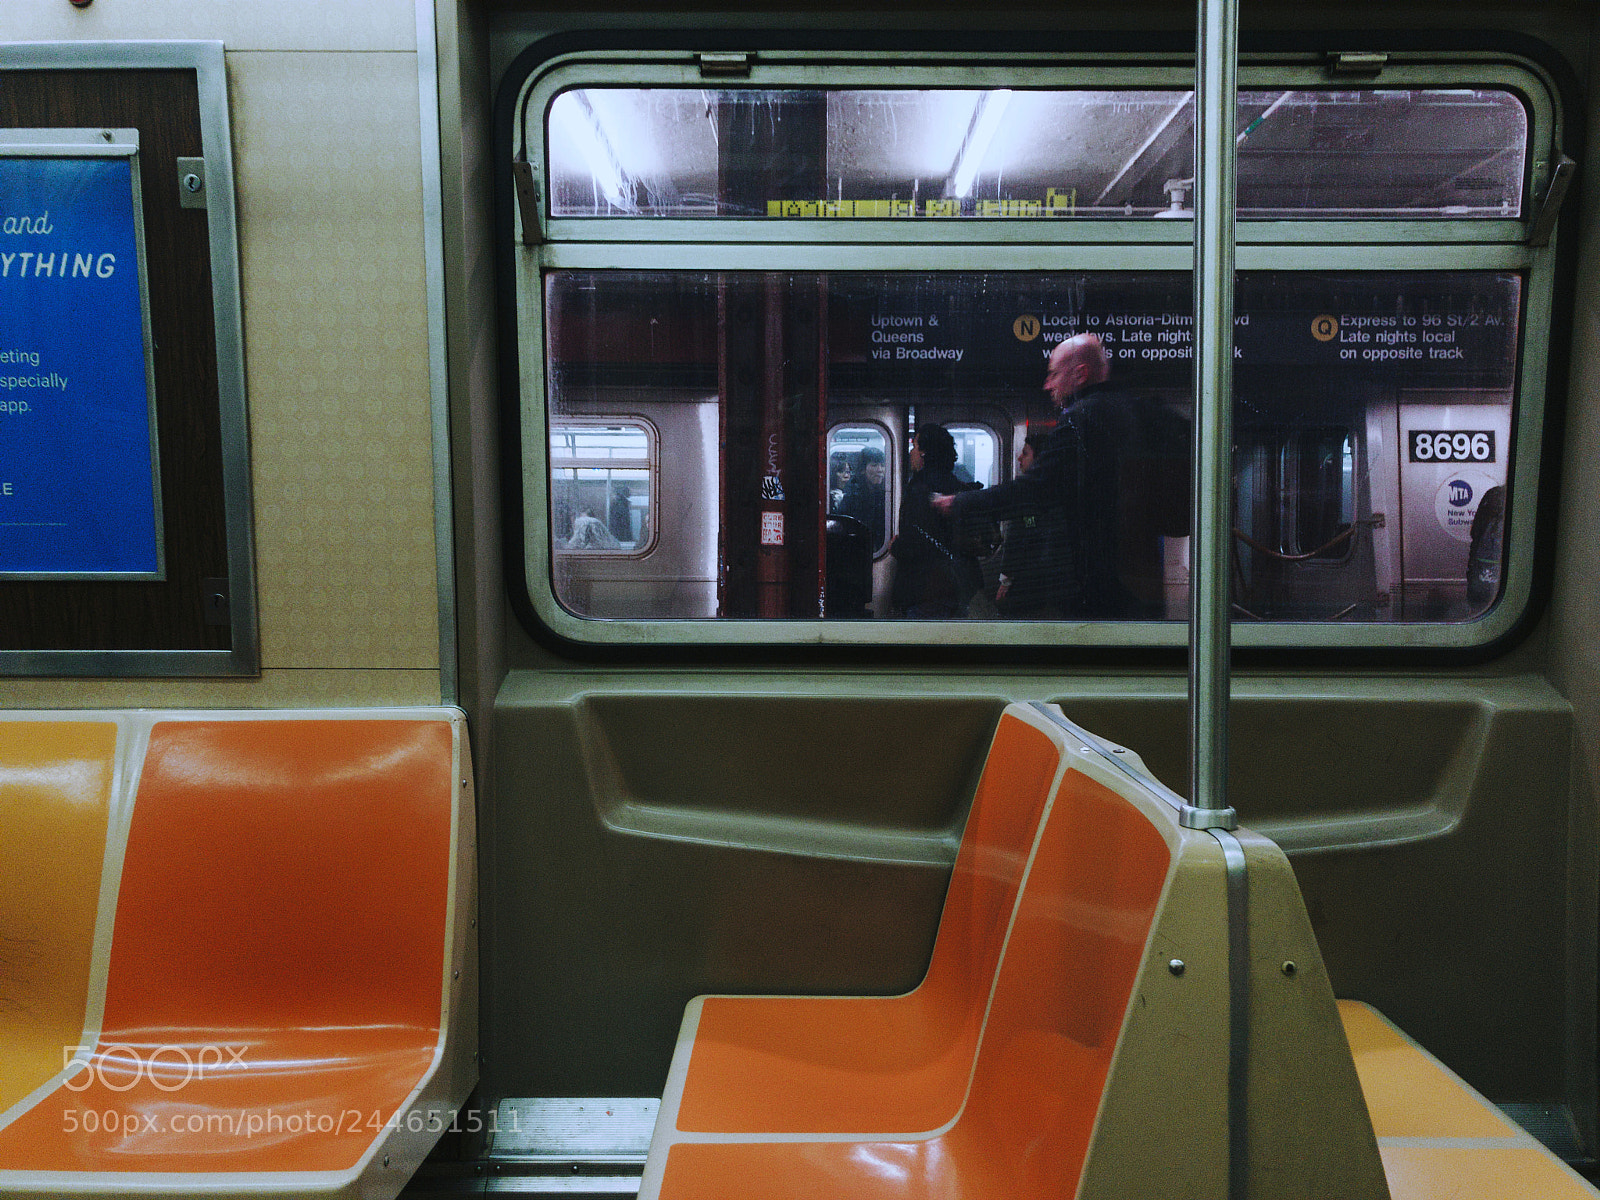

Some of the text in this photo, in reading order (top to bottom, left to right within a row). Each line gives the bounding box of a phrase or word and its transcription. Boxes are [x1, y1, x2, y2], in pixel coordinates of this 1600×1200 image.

[3, 210, 54, 235] and
[1, 252, 116, 279] YTHING
[871, 314, 939, 329] Uptown &
[1042, 312, 1250, 327] Local to Astoria-Ditm vd
[1340, 314, 1397, 329] Express
[1402, 314, 1417, 326] to
[1422, 314, 1442, 326] 96
[1447, 313, 1479, 328] St/2
[871, 330, 924, 343] Queens
[1122, 329, 1152, 343] Late
[1157, 329, 1194, 345] night
[1340, 330, 1455, 345] Late nights local
[0, 348, 40, 367] eting
[871, 346, 964, 362] via Broadway
[1119, 347, 1136, 359] on
[1141, 345, 1194, 361] opposit
[1339, 346, 1465, 362] on opposite track
[0, 400, 32, 415] app.
[1414, 432, 1490, 460] 8696
[0, 482, 14, 495] E
[1447, 509, 1466, 517] New
